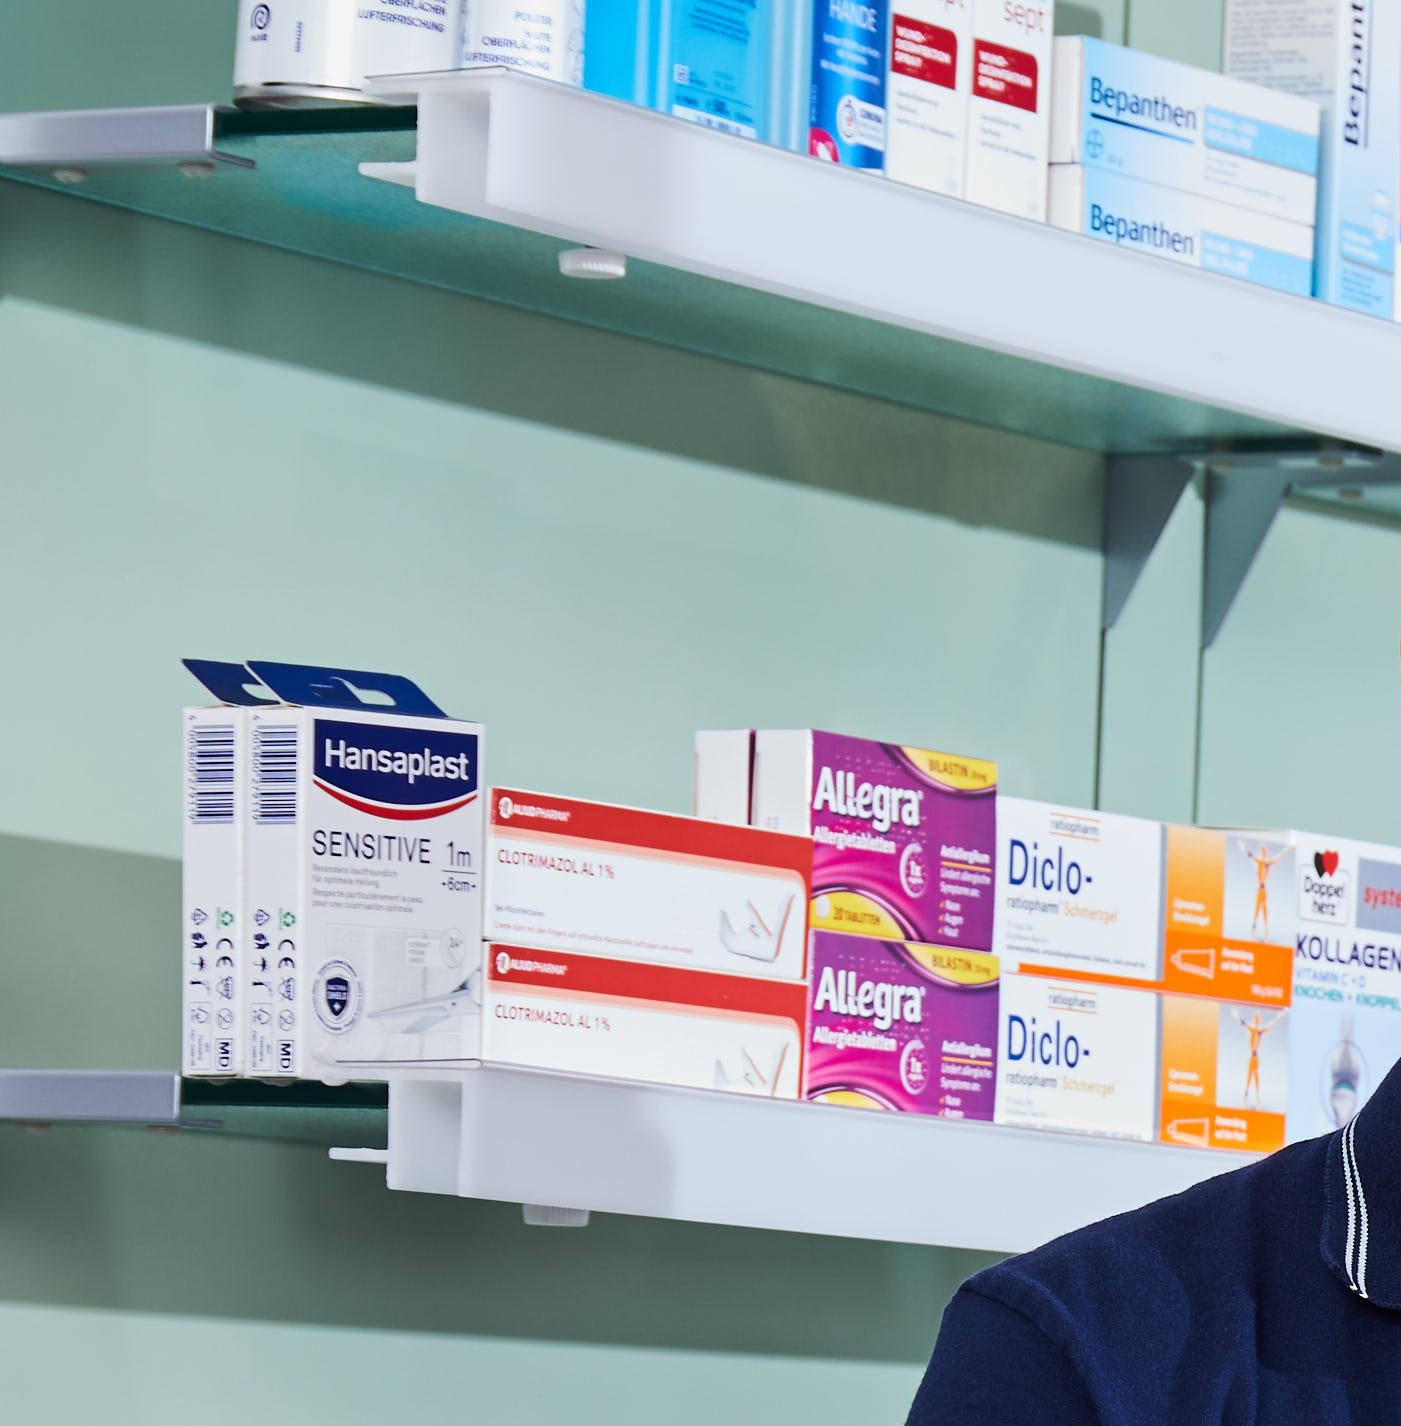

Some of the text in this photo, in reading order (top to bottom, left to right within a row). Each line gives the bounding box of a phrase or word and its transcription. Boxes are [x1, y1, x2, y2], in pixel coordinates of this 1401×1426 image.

[1003, 1, 1044, 33] sept
[1091, 77, 1196, 131] Bepanthen
[1091, 204, 1194, 256] Bepanthen
[325, 738, 470, 784] Hansaplast
[929, 759, 968, 778] BILASTIN
[813, 766, 920, 833] Allegra
[812, 825, 897, 855] Allergietabletten
[1051, 818, 1099, 837] ratiopharm
[312, 829, 431, 864] SENSITIVE
[497, 849, 595, 877] CLOTRIMAZOL AL
[1008, 838, 1093, 895] Diclo-
[1304, 876, 1345, 899] Doppel
[844, 908, 880, 925] TABLETTEN
[1006, 897, 1118, 925] ratiopharm Schmerzgel
[1312, 900, 1336, 916] herz
[932, 954, 971, 971] BILASTIN
[1296, 967, 1338, 984] VITAMIN
[814, 966, 921, 1030] Allegra
[1048, 992, 1096, 1009] ratiopharm
[1293, 985, 1344, 1001] KNOCHEN
[1356, 993, 1401, 1011] KNORPEL
[495, 1003, 591, 1029] CLOTRIMAZOL AL
[812, 1026, 897, 1052] Allergietabletten
[1007, 1014, 1090, 1069] Diclo-
[1005, 1071, 1115, 1097] ratiopharm Schmerzgel
